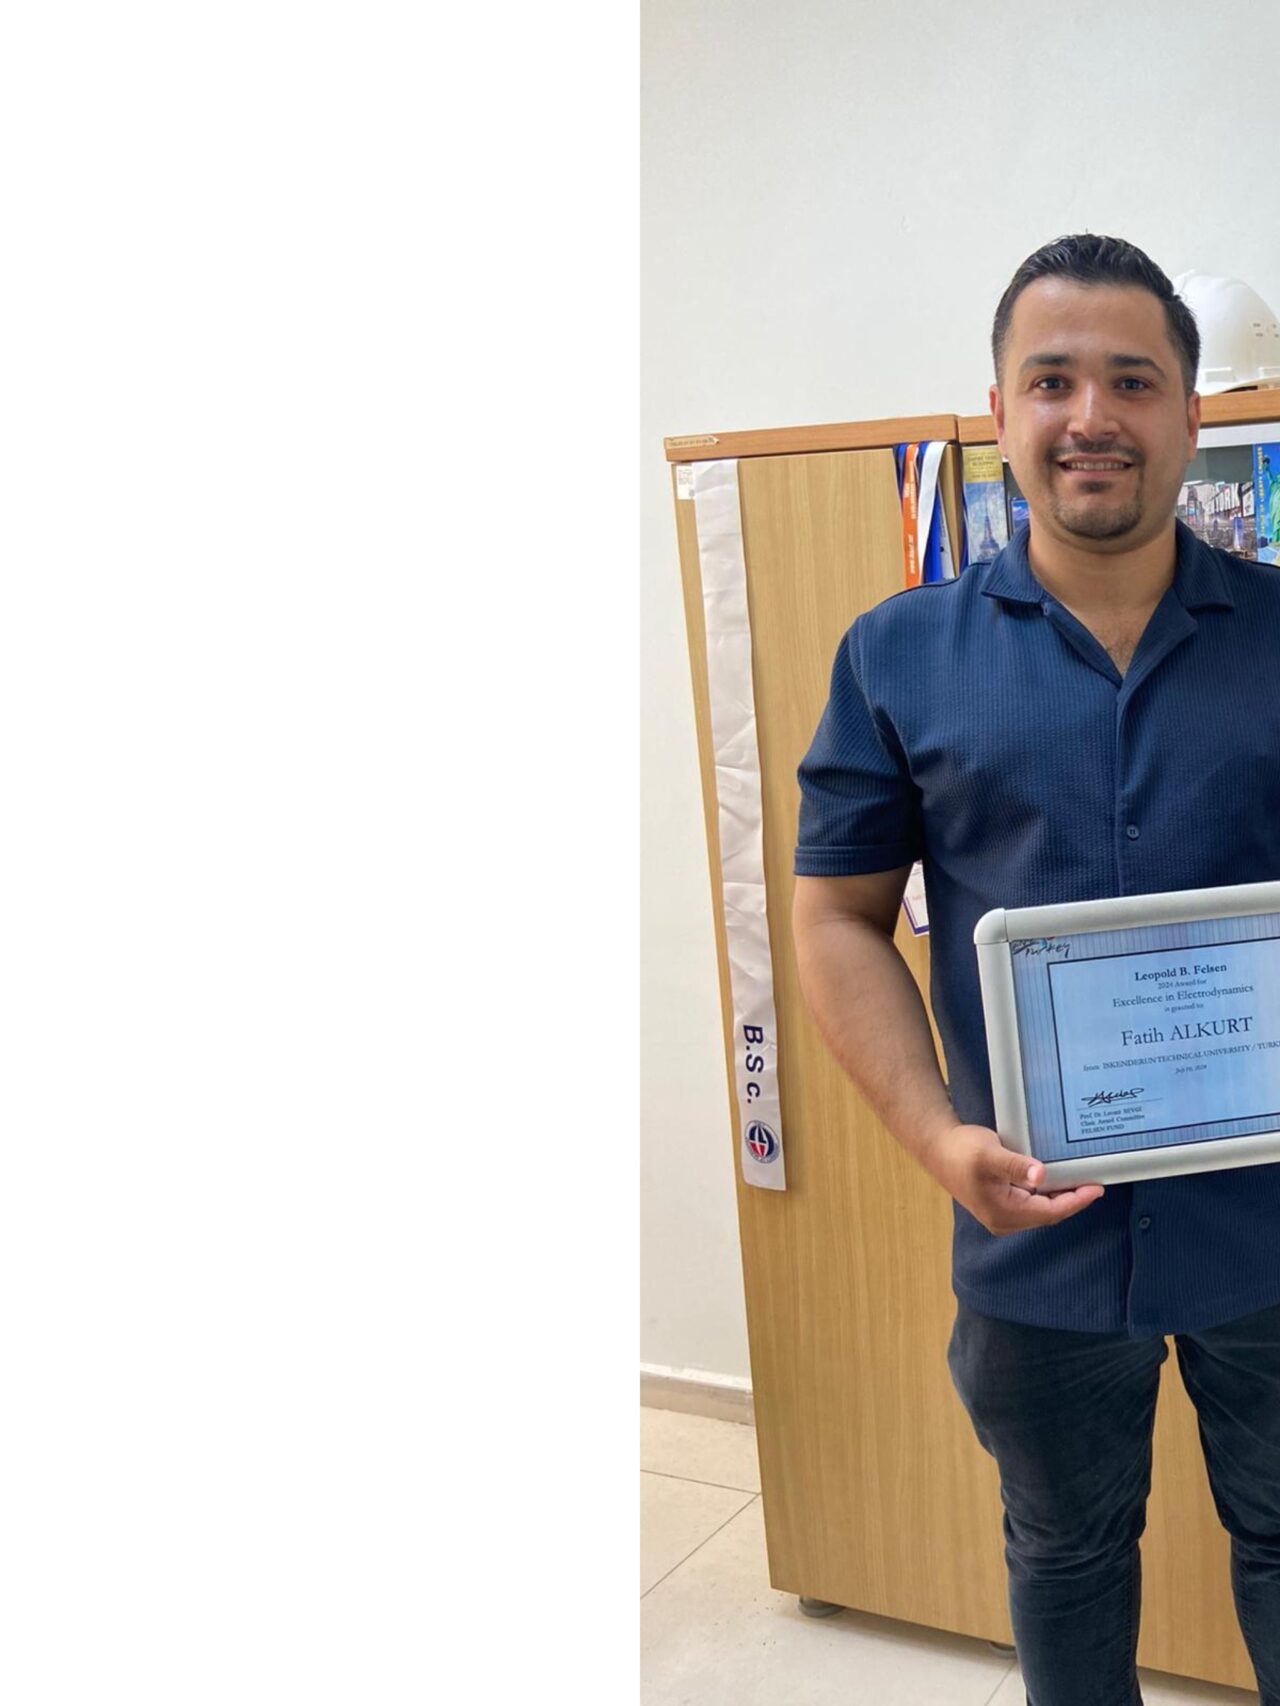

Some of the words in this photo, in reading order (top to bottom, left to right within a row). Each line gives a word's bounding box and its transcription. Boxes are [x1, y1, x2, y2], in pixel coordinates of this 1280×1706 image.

[1135, 968, 1177, 981] Leopold
[1179, 967, 1191, 976] B.
[1194, 964, 1228, 975] Felsen
[1113, 995, 1163, 1008] Excellence
[1165, 992, 1175, 1001] in
[1177, 985, 1254, 1000] Electrodynamics
[1121, 1027, 1164, 1047] Fatih
[1170, 1016, 1253, 1041] ALKURT
